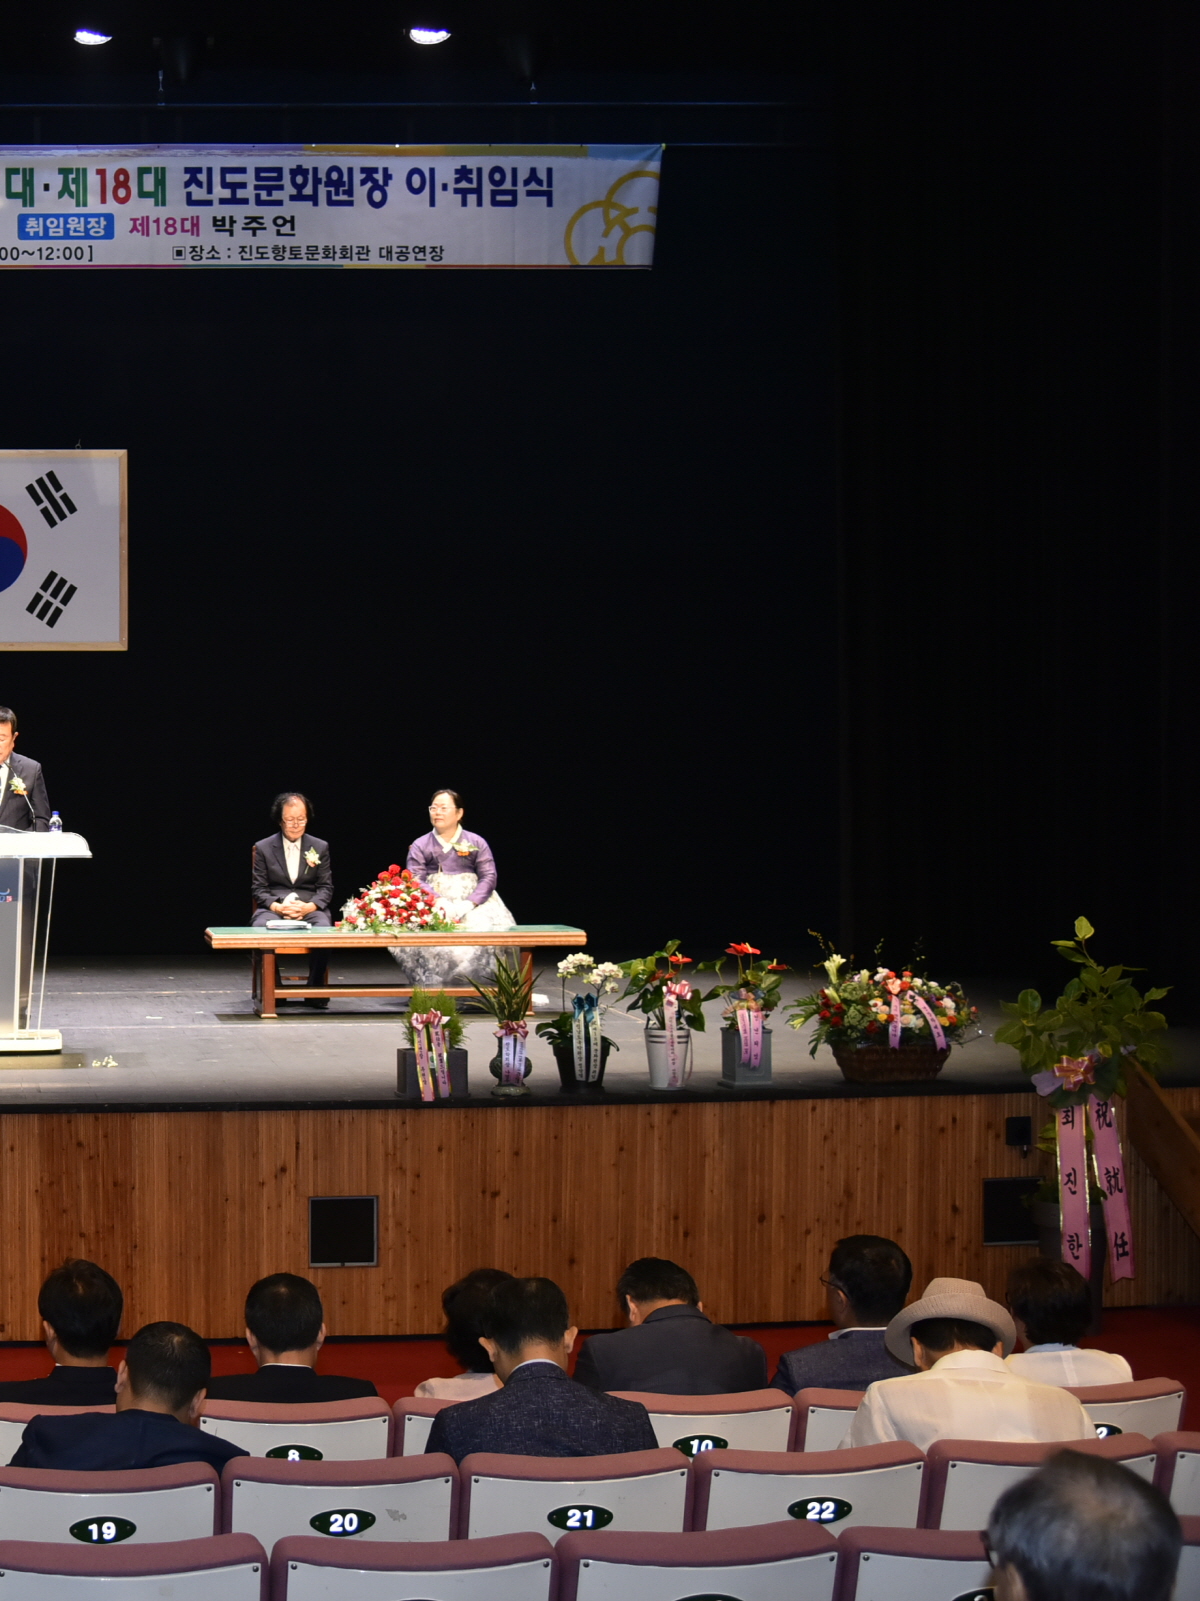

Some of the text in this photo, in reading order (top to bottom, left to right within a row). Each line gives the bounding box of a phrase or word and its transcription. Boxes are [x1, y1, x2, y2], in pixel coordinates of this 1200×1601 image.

[183, 164, 393, 209] 진도문화원장
[406, 165, 554, 208] 이·취임식
[25, 216, 107, 237] 취임원장
[129, 215, 200, 238] 제18대
[212, 215, 297, 238] 박주언
[238, 245, 371, 261] 진도향토문화회관
[378, 245, 445, 261] 대공연장
[287, 1449, 300, 1461] 8
[566, 1508, 594, 1528] 21
[805, 1501, 836, 1521] 22
[87, 1521, 117, 1541] 19
[328, 1512, 359, 1533] 20
